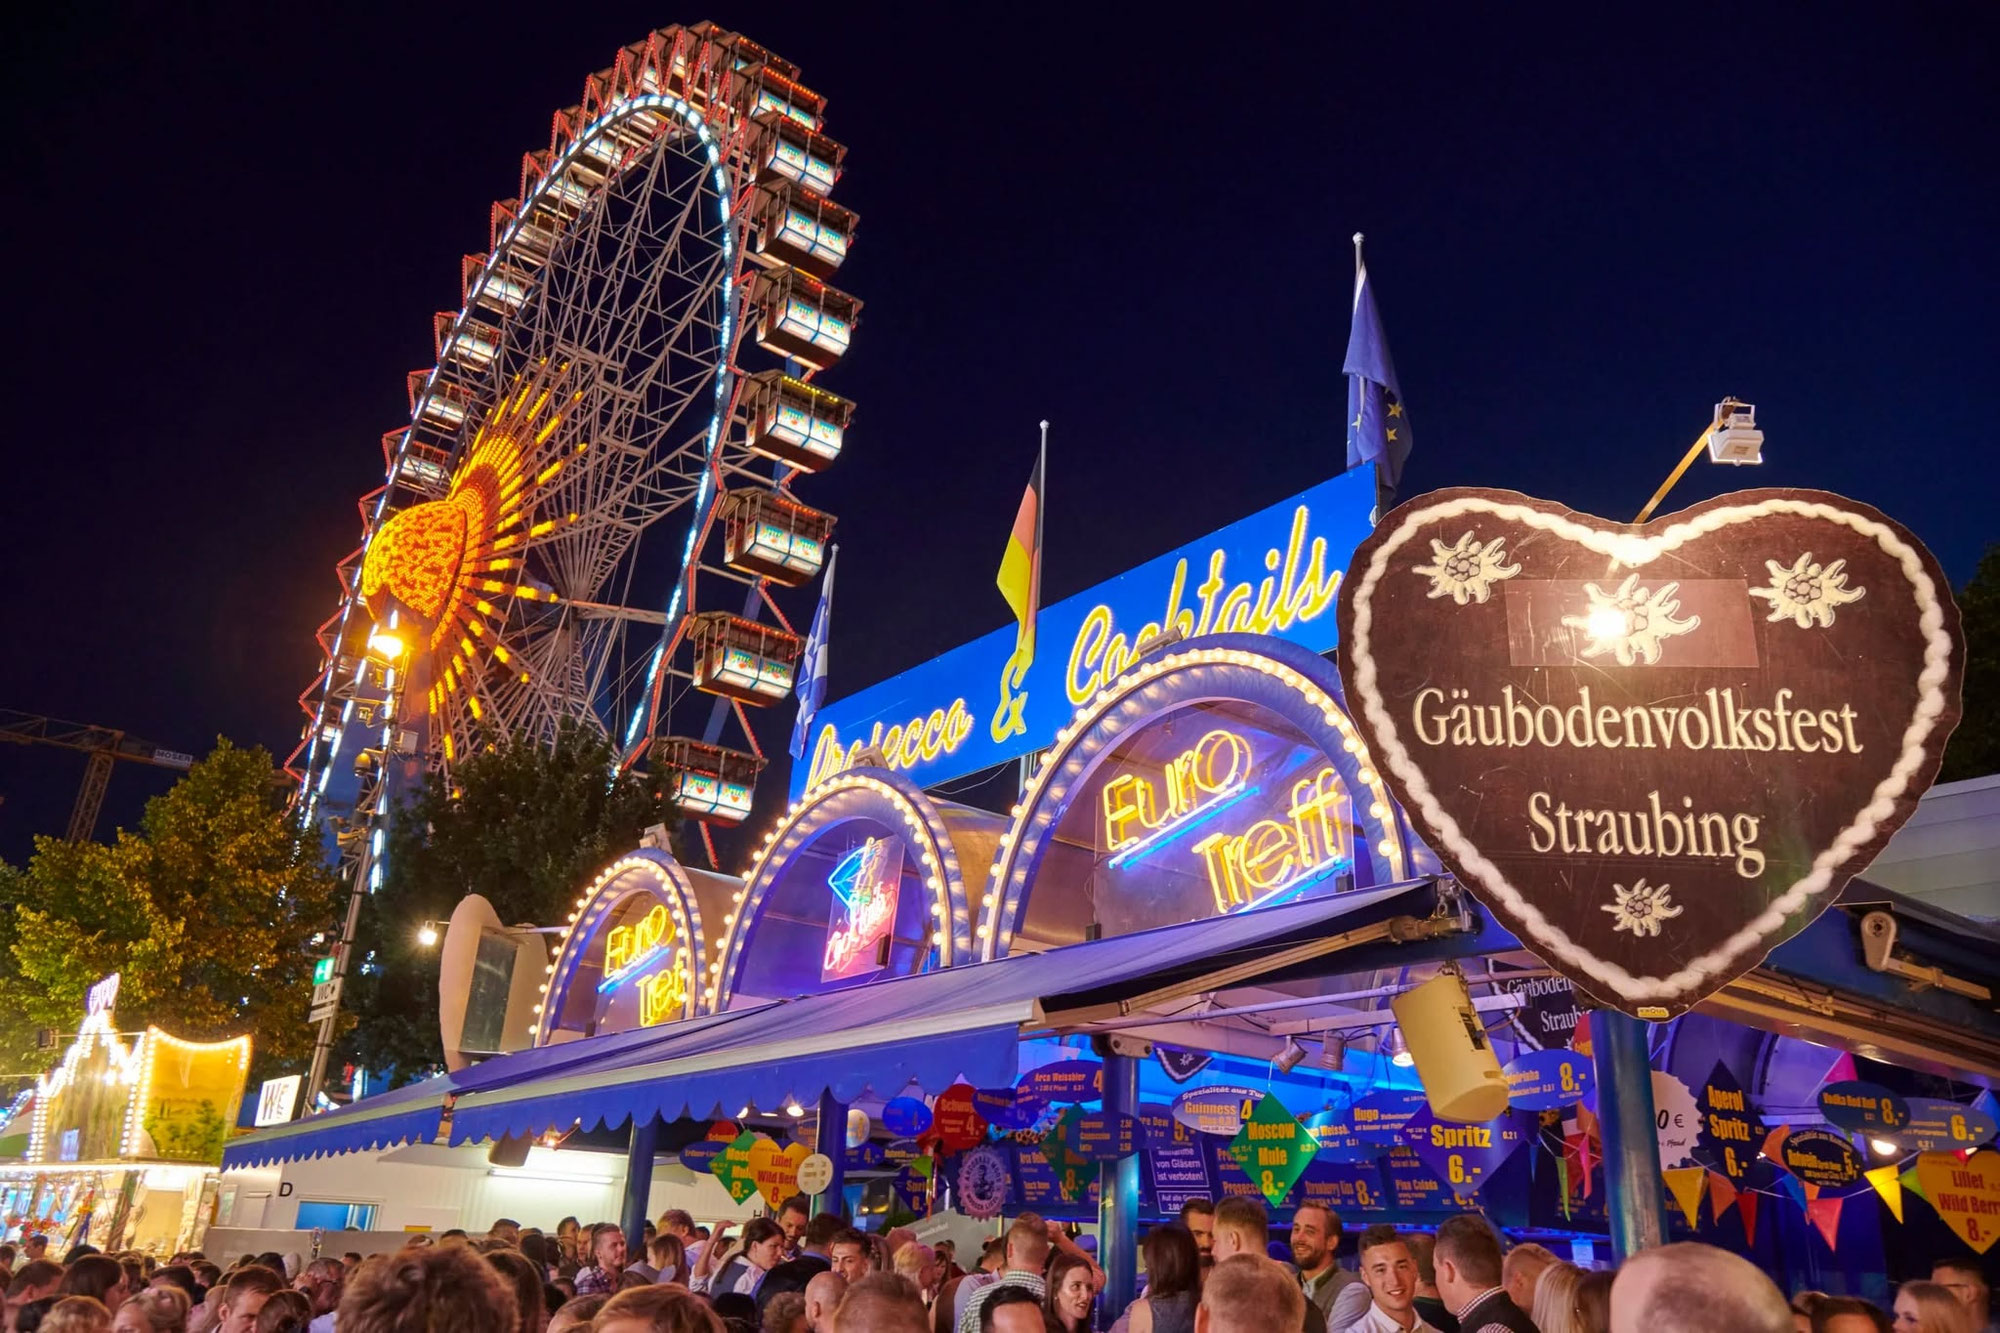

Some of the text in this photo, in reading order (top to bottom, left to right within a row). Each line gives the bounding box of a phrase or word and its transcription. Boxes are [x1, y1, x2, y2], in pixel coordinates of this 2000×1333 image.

[1411, 686, 1864, 755] Gäubodenvolksfest
[1102, 729, 1247, 851] Euro
[1192, 766, 1346, 914] Treff
[1528, 790, 1767, 879] Straubing
[604, 904, 672, 979] Euro
[1559, 1062, 1586, 1092] 8.-
[1182, 1086, 1230, 1101] Spezialität
[1707, 1085, 1745, 1112] Aperol
[1184, 1099, 1252, 1120] Guinness 4
[1354, 1107, 1379, 1123] Hugo
[1674, 1114, 1685, 1128] €
[1881, 1097, 1904, 1126] 8.-
[1247, 1122, 1296, 1140] Moscow
[1430, 1123, 1492, 1149] Spritz
[1709, 1113, 1751, 1142] Spritz
[1951, 1114, 1984, 1141] 6.-
[726, 1148, 750, 1162] Mosc
[771, 1154, 792, 1168] Lillet
[1171, 1159, 1201, 1169] Gläsern
[1258, 1147, 1288, 1167] Mule
[1725, 1146, 1748, 1178] 6.-
[757, 1170, 777, 1184] Wild
[779, 1171, 798, 1184] Berr
[1167, 1171, 1204, 1181] verboten!
[1448, 1154, 1482, 1184] 6.-
[1951, 1169, 1985, 1190] Lillet
[278, 1182, 293, 1198] D
[731, 1181, 749, 1199] 8.-
[1262, 1170, 1285, 1196] 8.-
[1355, 1179, 1380, 1206] 8.-
[1937, 1192, 2000, 1216] Wild Berr
[1966, 1216, 1992, 1243] 8.-
